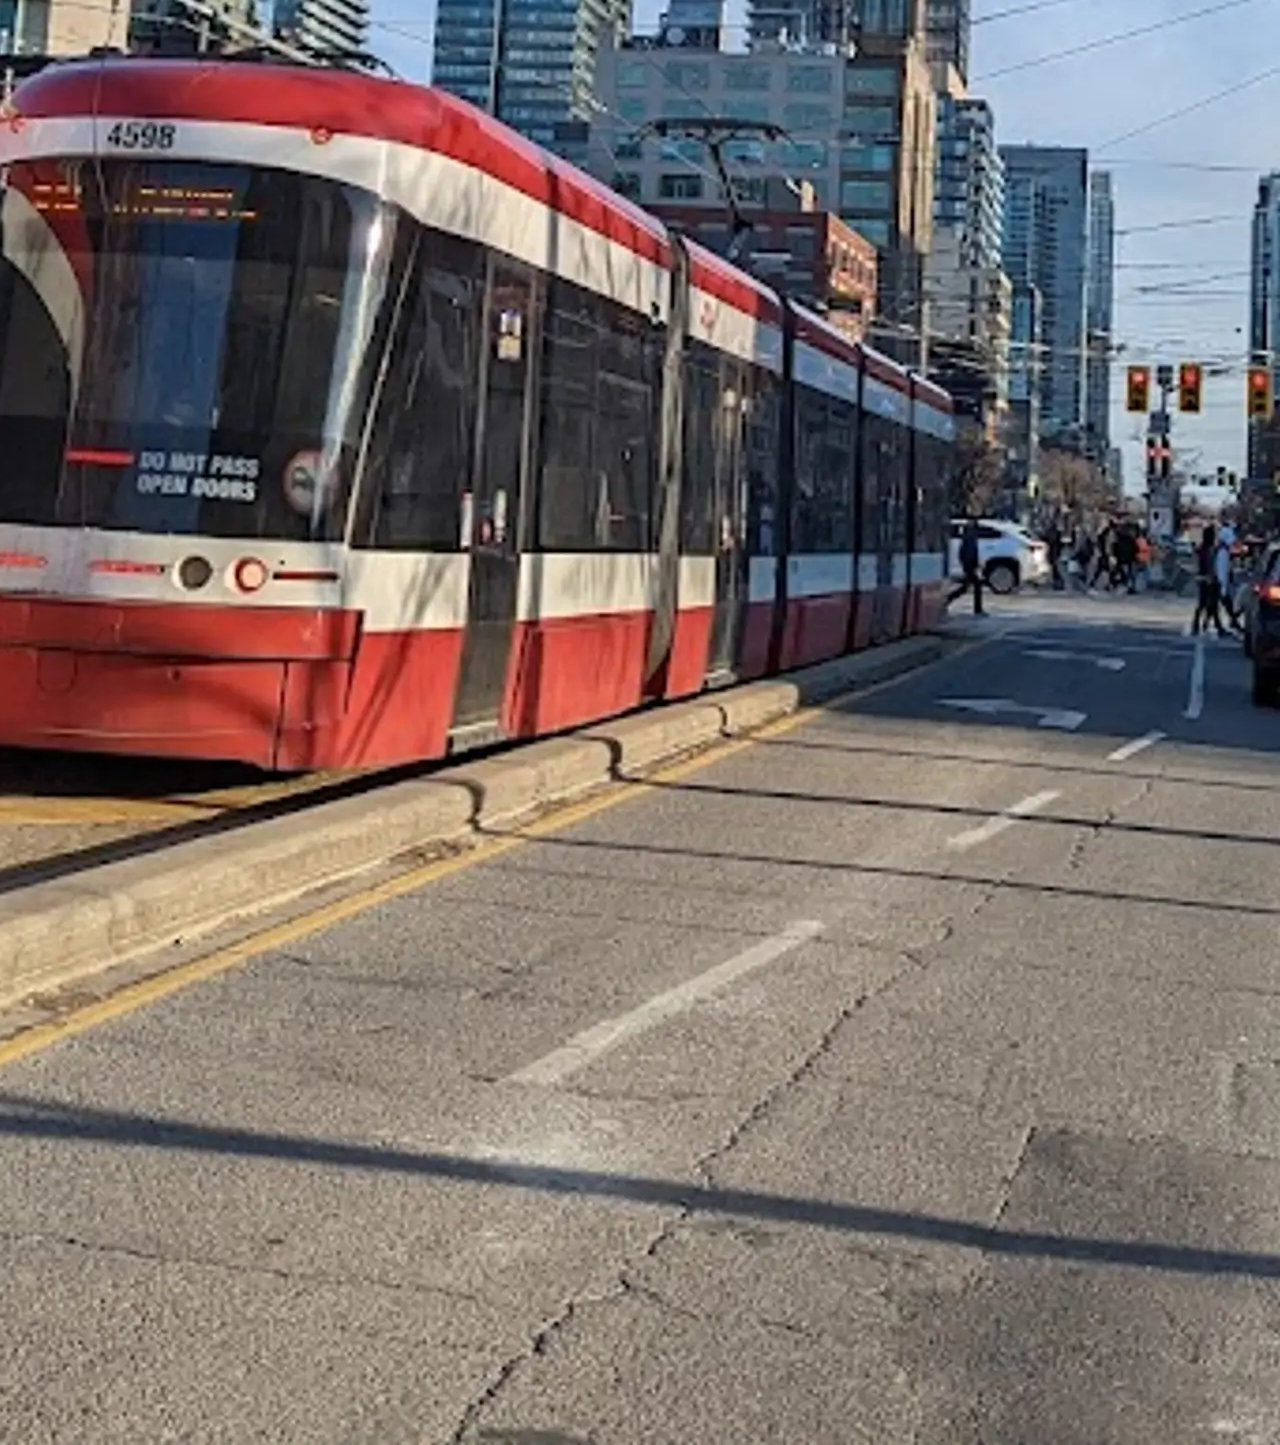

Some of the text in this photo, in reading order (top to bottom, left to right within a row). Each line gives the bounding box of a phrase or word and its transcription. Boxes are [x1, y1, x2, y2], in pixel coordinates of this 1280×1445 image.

[107, 122, 176, 149] 4598
[140, 451, 259, 477] DO NOT PASS
[137, 474, 256, 501] OPEN DOORS
